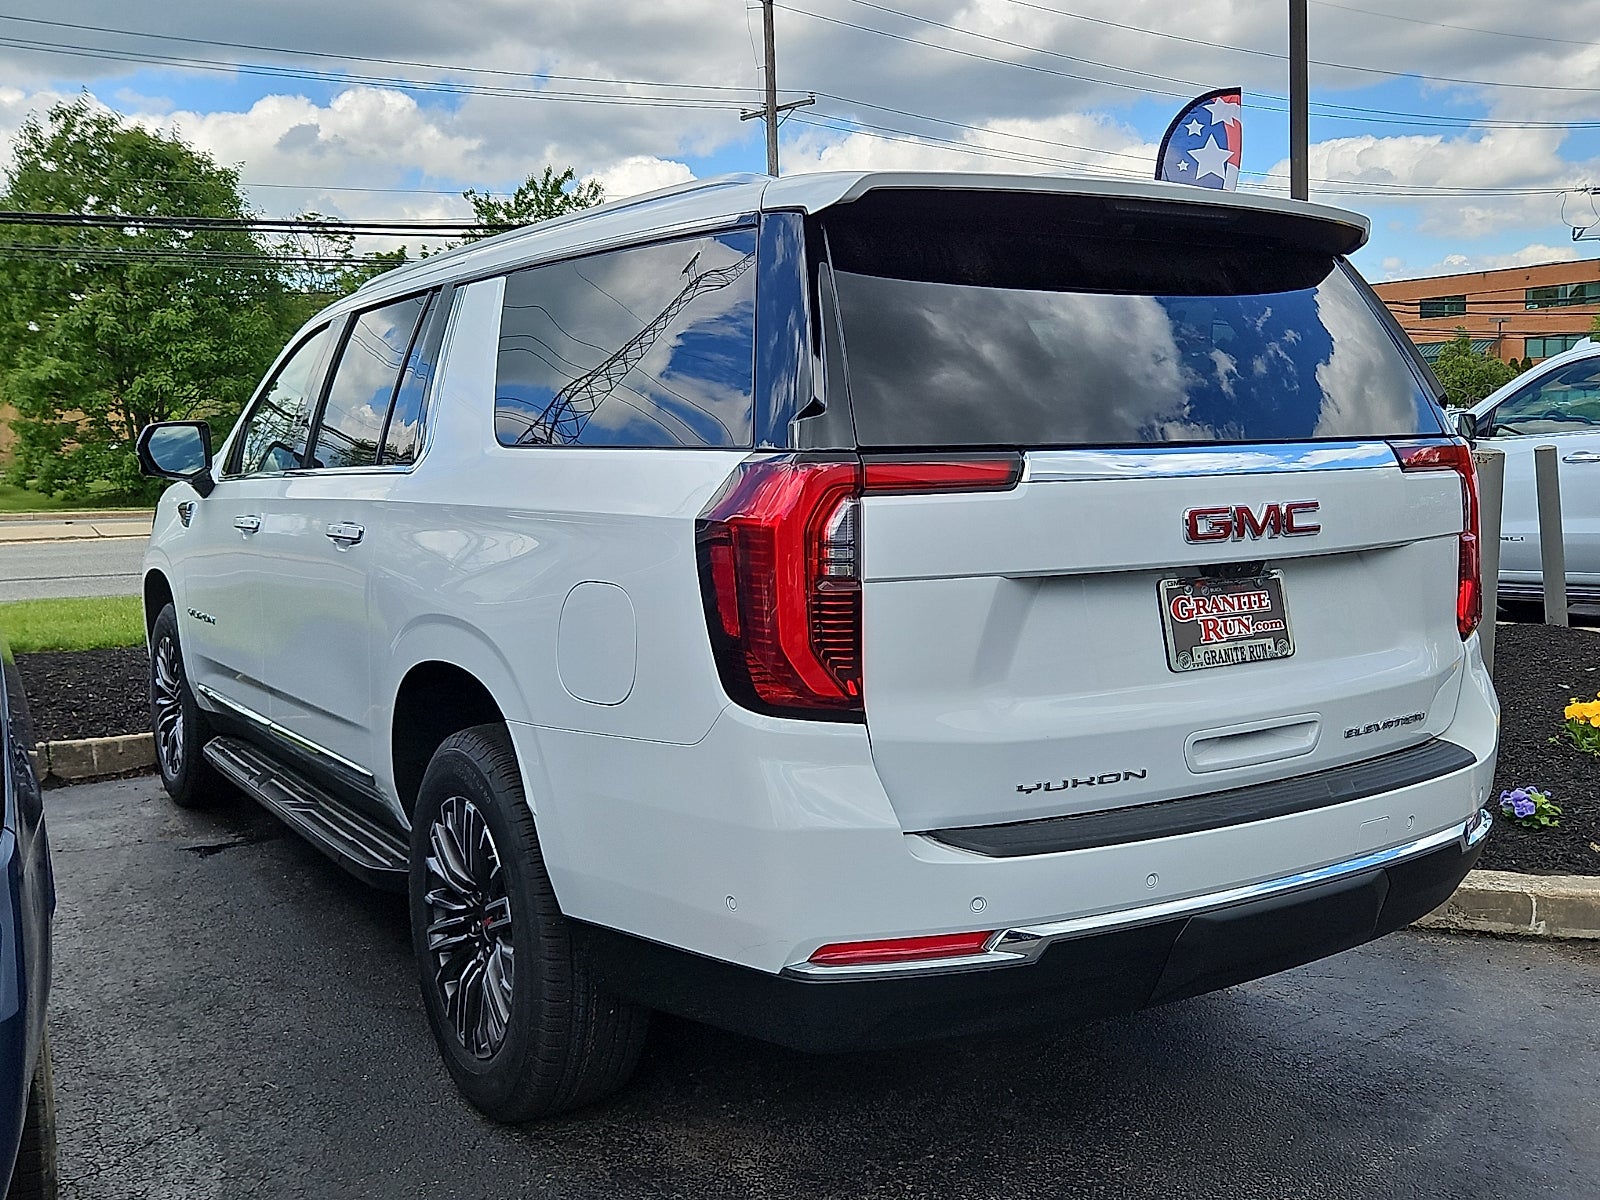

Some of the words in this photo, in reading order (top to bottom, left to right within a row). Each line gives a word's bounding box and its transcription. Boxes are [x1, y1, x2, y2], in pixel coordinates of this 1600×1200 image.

[1183, 499, 1321, 544] GMC
[1171, 591, 1270, 621] GRANITE
[1343, 712, 1426, 738] ELEVATION
[1016, 768, 1147, 795] YUKON
